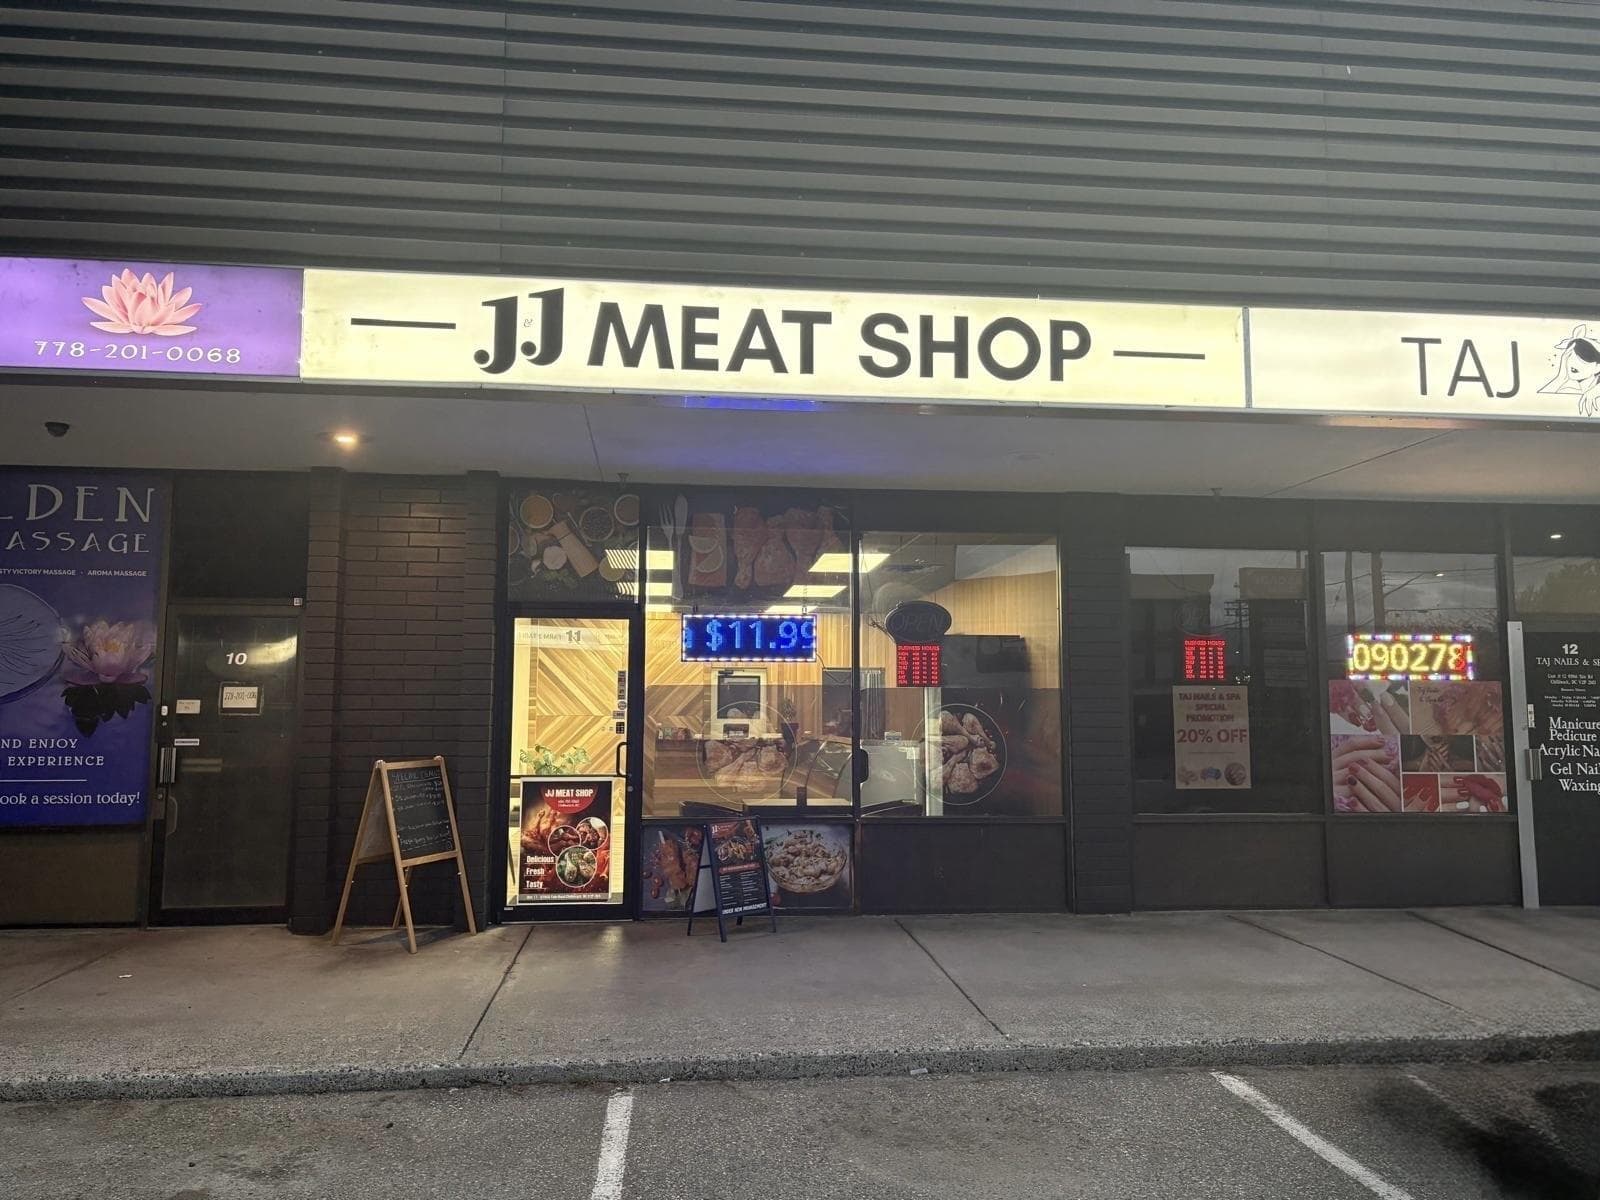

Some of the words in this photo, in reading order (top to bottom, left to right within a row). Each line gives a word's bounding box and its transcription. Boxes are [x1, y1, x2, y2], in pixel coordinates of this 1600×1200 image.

[587, 301, 832, 375] MEAT
[858, 311, 1092, 382] SHOP
[34, 340, 242, 364] 778-201-0068
[1401, 336, 1521, 400] TAJ
[5, 531, 150, 554] ASSAGE
[12, 567, 42, 576] VICTORY
[43, 568, 77, 577] MASSAGE
[87, 569, 113, 577] AROMA
[114, 569, 147, 578] MASSAGE
[565, 630, 582, 642] 11
[706, 619, 814, 651] $11.99
[1562, 643, 1579, 655] 12
[226, 652, 248, 665] 10
[1353, 642, 1464, 672] 090278
[1536, 657, 1551, 667] TAJ
[1553, 657, 1580, 666] NAILS
[1582, 658, 1590, 666] &
[1549, 716, 1600, 730] Manicure
[1176, 729, 1213, 743] 20%
[1217, 729, 1247, 743] OFF
[1549, 729, 1597, 742] Pedicure
[29, 738, 79, 749] ENJOY
[1539, 743, 1581, 760] Acrylic
[8, 756, 105, 766] EXPERIENCE
[1550, 762, 1573, 775] Gel
[31, 796, 39, 805] a
[43, 793, 92, 805] session
[97, 792, 140, 807] today!
[545, 788, 555, 798] JJ
[555, 788, 574, 797] MEAT
[575, 788, 594, 797] SHOP
[526, 855, 555, 863] Delicious
[526, 867, 545, 875] Fresh
[526, 880, 544, 888] Tasty
